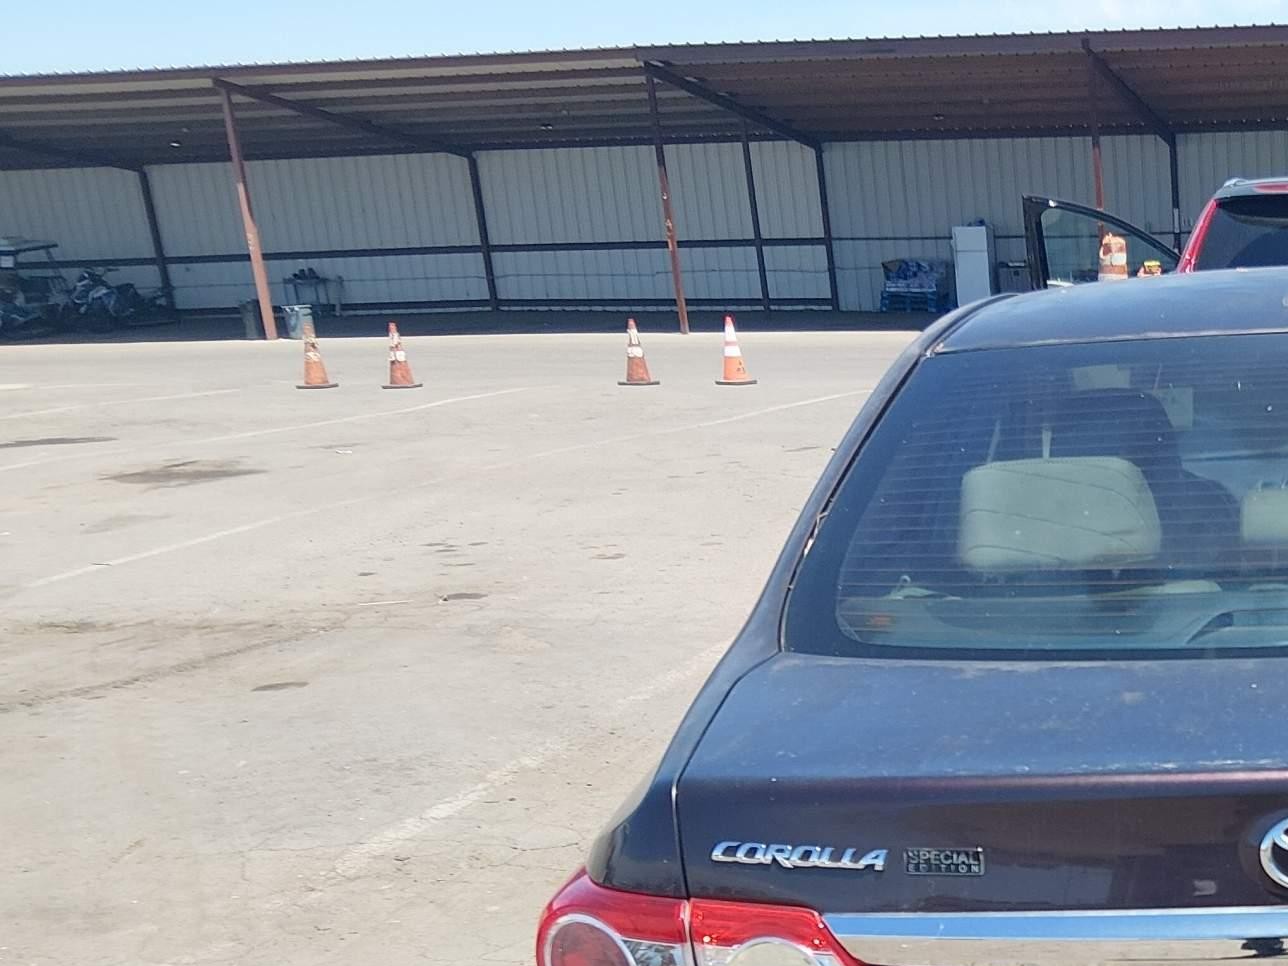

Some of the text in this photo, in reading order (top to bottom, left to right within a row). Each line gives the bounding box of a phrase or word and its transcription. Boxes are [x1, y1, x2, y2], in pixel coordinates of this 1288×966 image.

[711, 841, 888, 871] COROLLA
[907, 850, 980, 864] SPECIAL
[907, 863, 980, 873] EDITION
